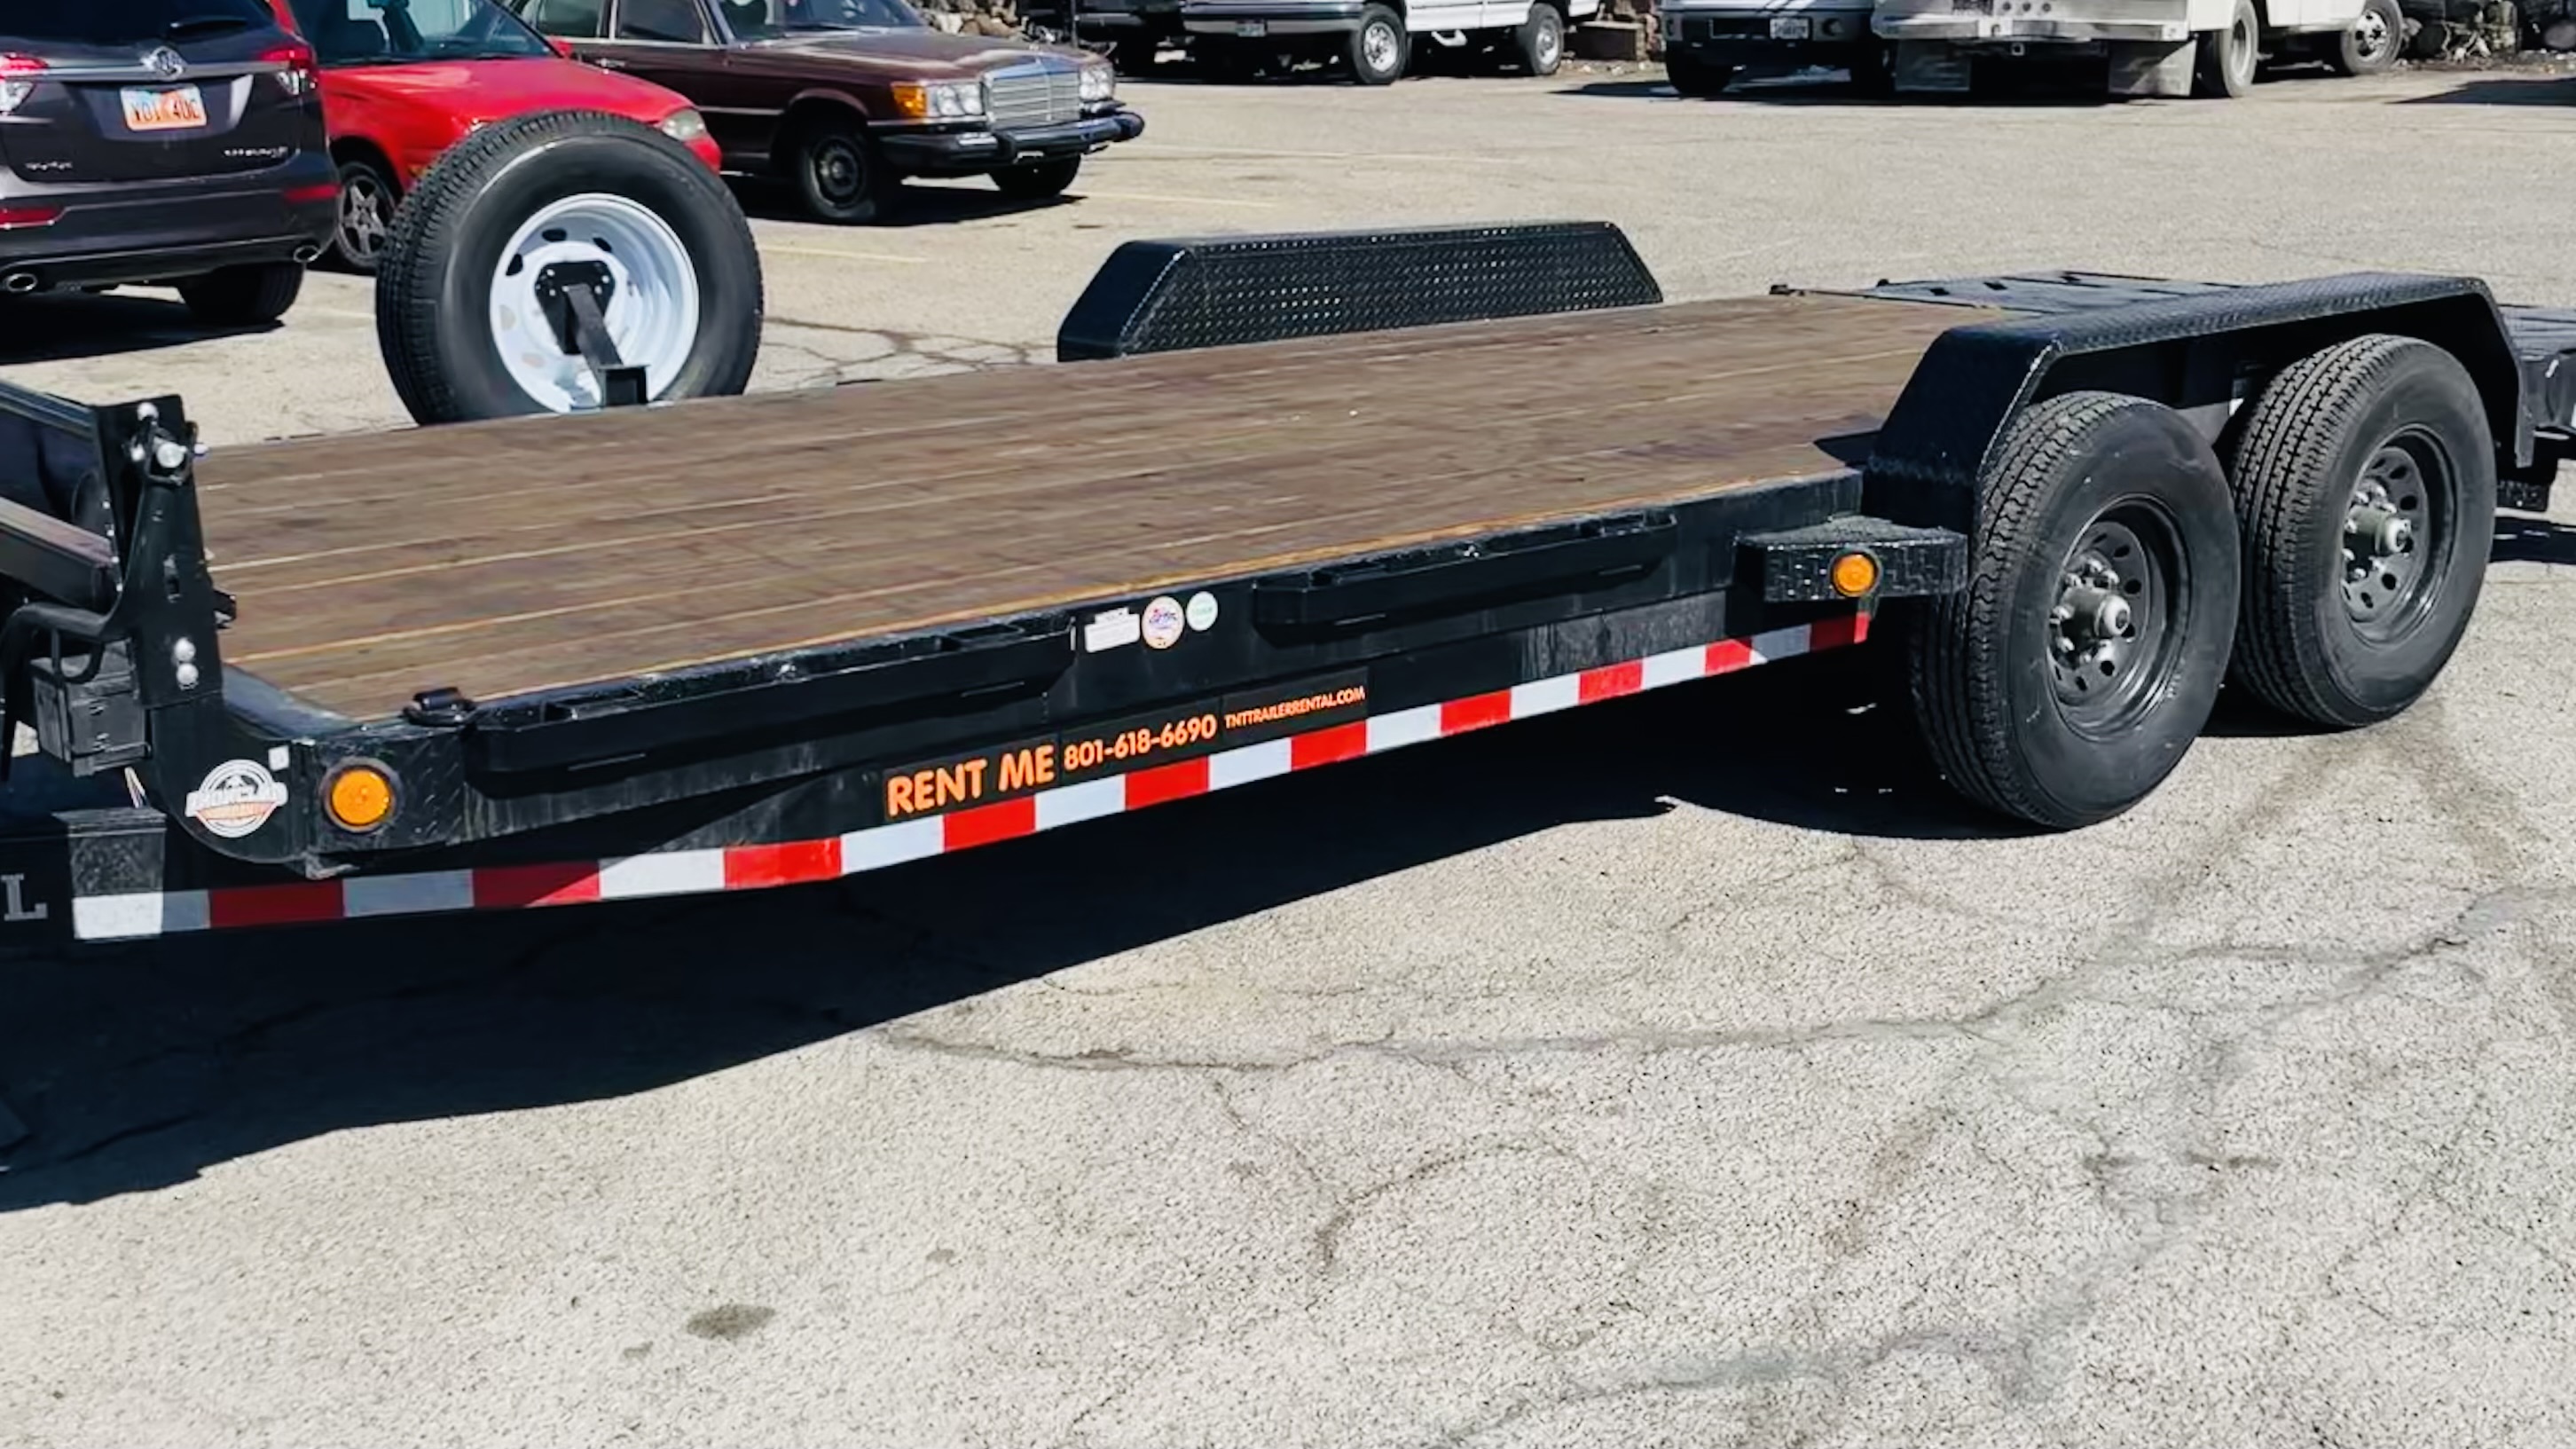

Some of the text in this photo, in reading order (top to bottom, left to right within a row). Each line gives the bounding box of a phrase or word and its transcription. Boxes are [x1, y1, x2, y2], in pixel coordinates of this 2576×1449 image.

[887, 686, 1366, 816] RENT ME 801-618-6690 TNTTRAILERRENTAL.COM
